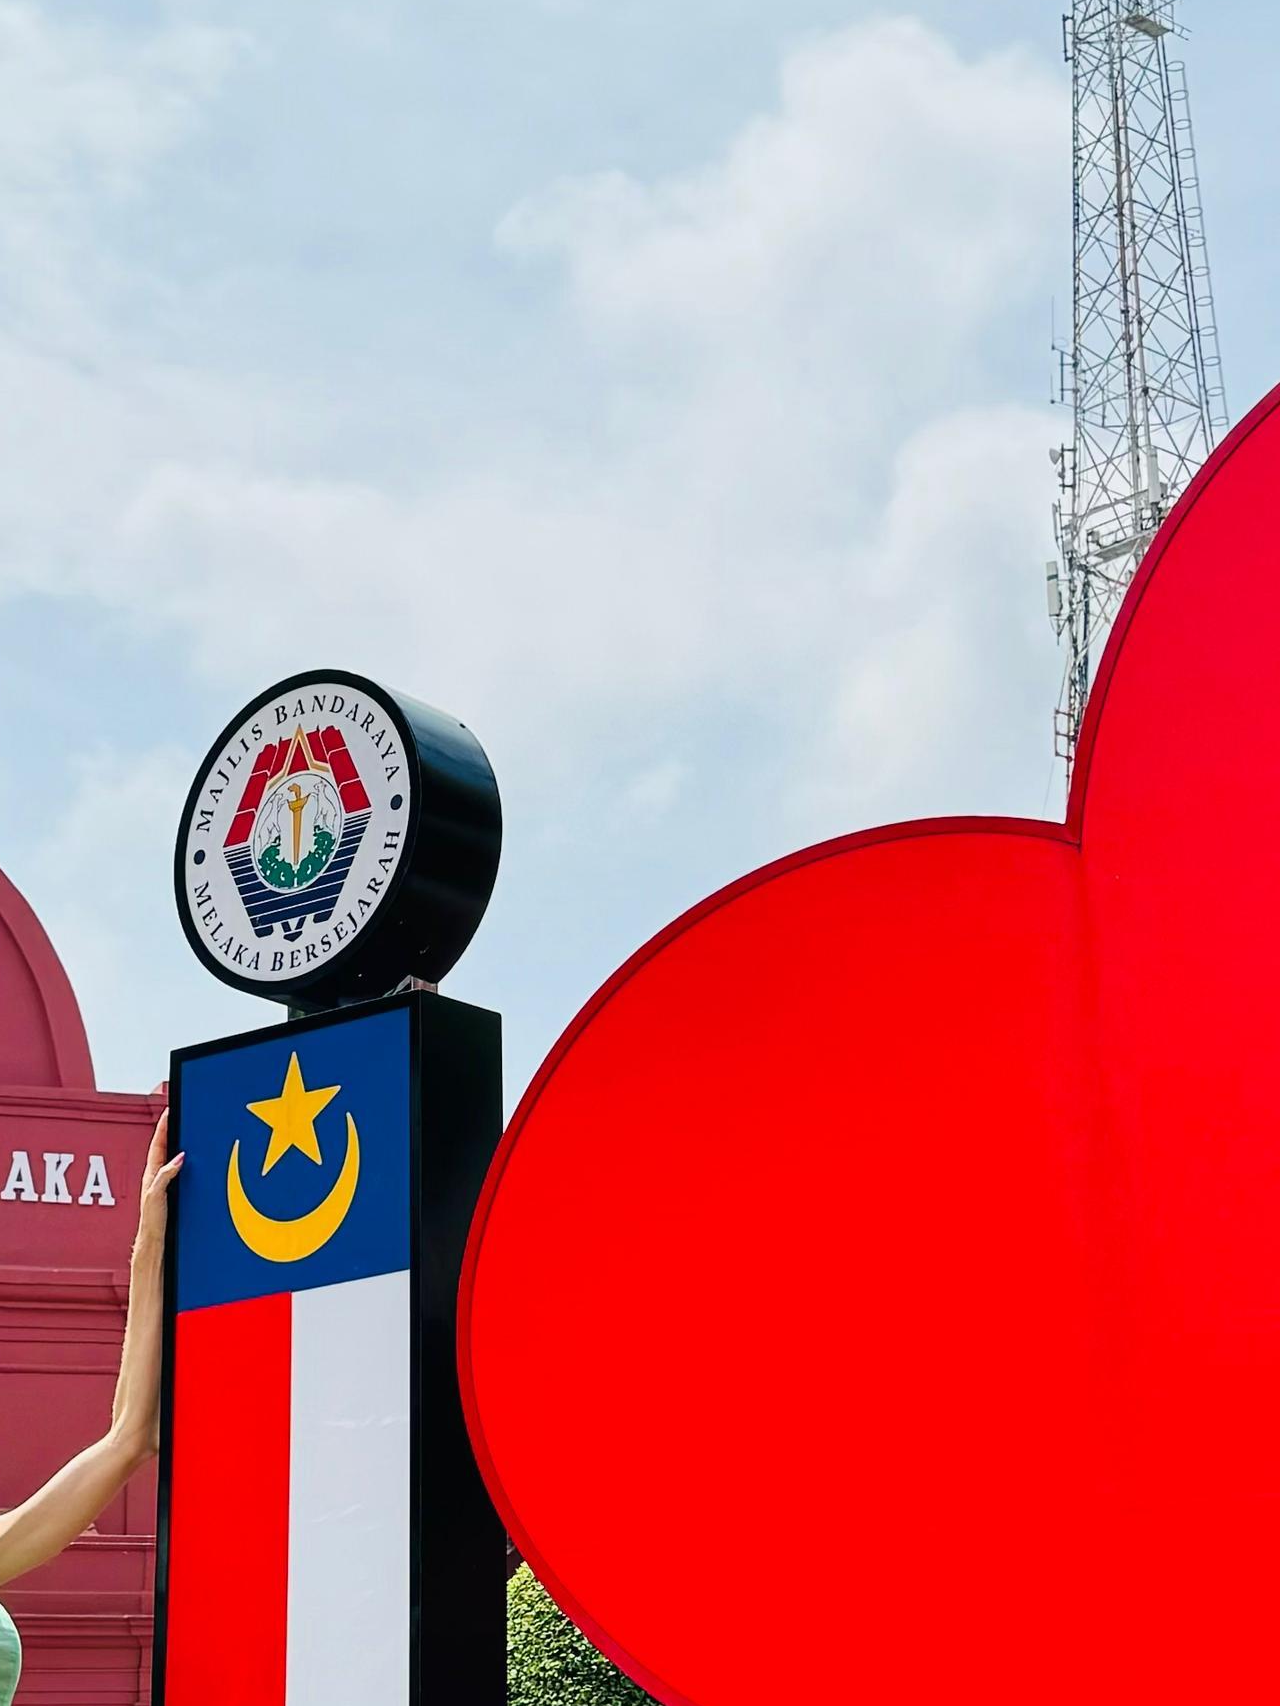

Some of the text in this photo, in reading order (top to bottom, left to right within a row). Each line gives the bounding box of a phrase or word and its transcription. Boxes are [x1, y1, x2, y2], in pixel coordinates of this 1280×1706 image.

[196, 694, 400, 833] MAJLIS BANDARAYA
[195, 830, 400, 972] MELAKA BERSEJARAH
